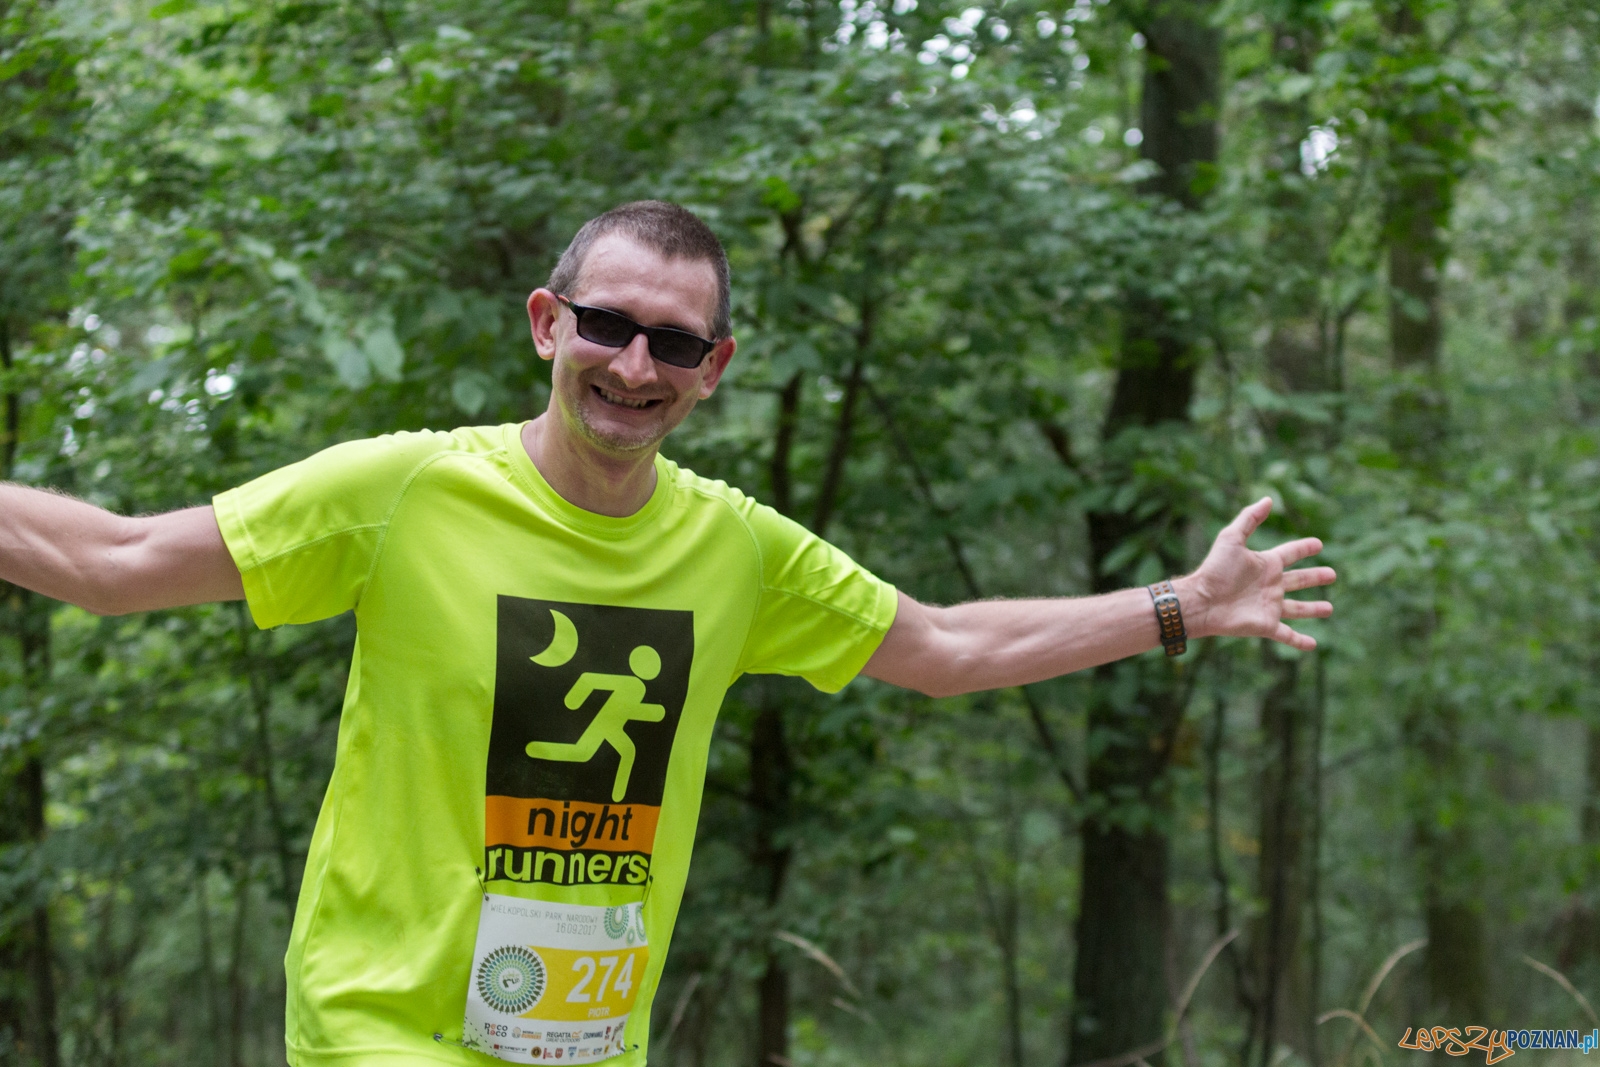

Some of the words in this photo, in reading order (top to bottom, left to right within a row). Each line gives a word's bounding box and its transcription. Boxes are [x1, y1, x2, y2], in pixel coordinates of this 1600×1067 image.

[527, 801, 633, 849] night
[487, 848, 649, 884] runners
[490, 904, 542, 918] WIELKOPOLSKI
[545, 912, 562, 921] PARK
[565, 953, 635, 1003] 274
[588, 1006, 611, 1018] PIOTR
